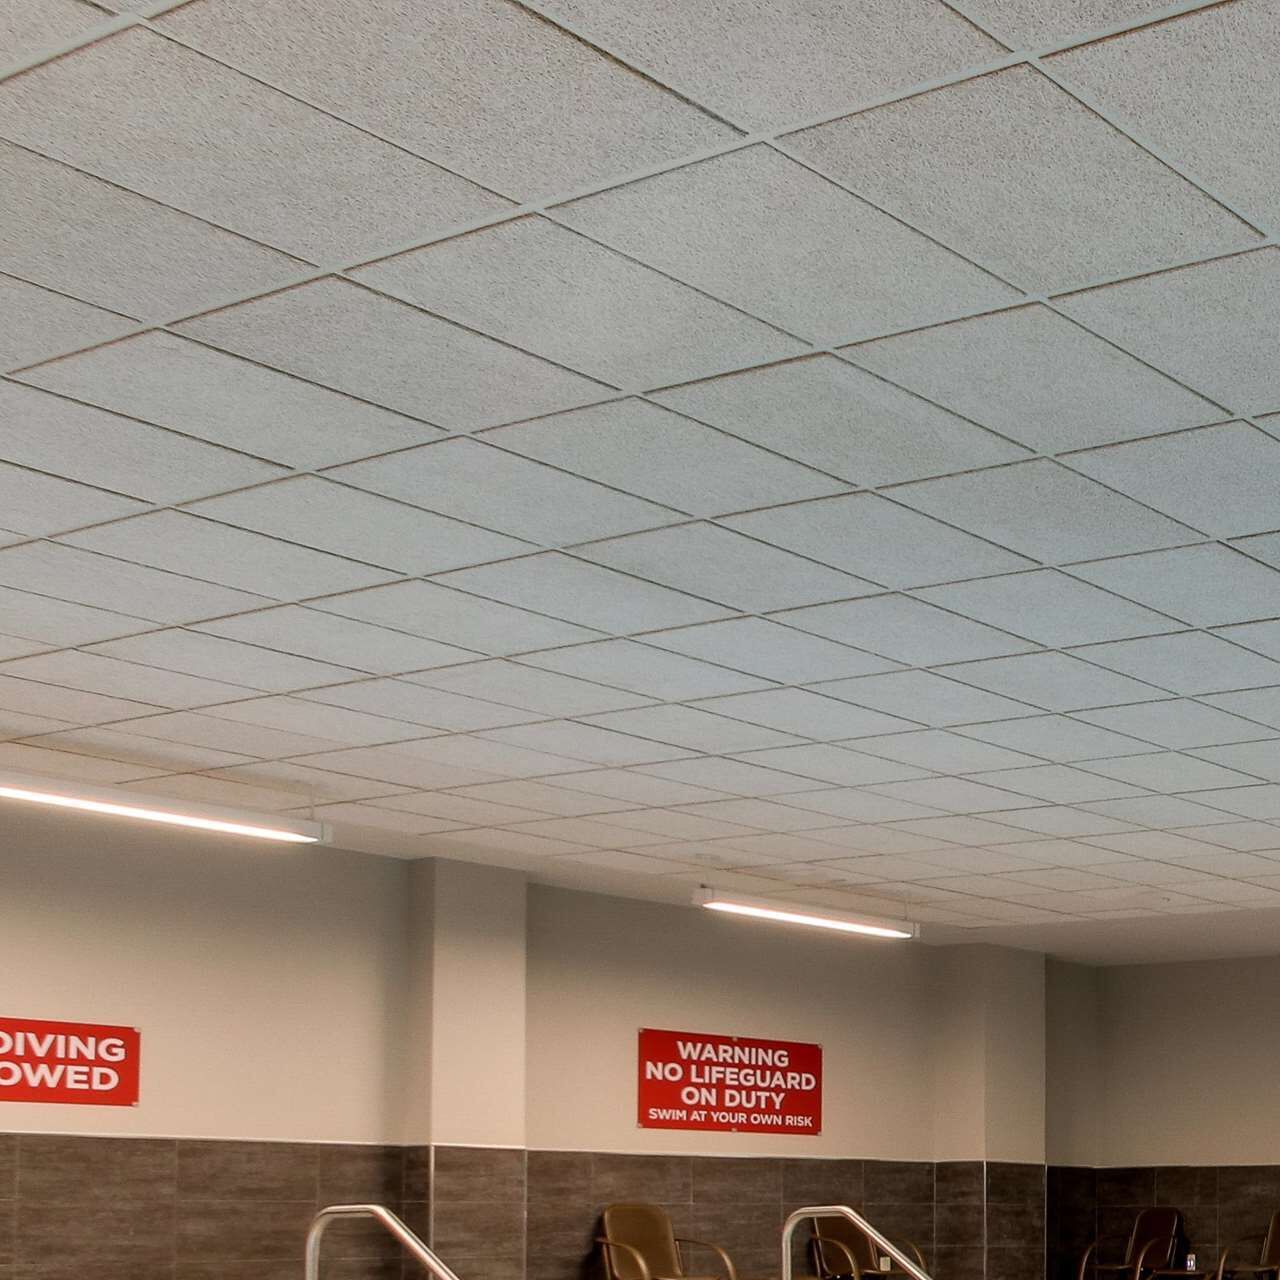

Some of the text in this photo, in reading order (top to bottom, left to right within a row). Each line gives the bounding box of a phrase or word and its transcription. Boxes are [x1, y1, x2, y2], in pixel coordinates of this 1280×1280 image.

[677, 1041, 789, 1067] WARNING
[0, 1061, 120, 1091] OWED
[646, 1062, 816, 1090] NO LIFEGUARD
[681, 1087, 785, 1110] ON DUTY
[648, 1108, 812, 1127] SWIM AT YOUR OWN RISK
